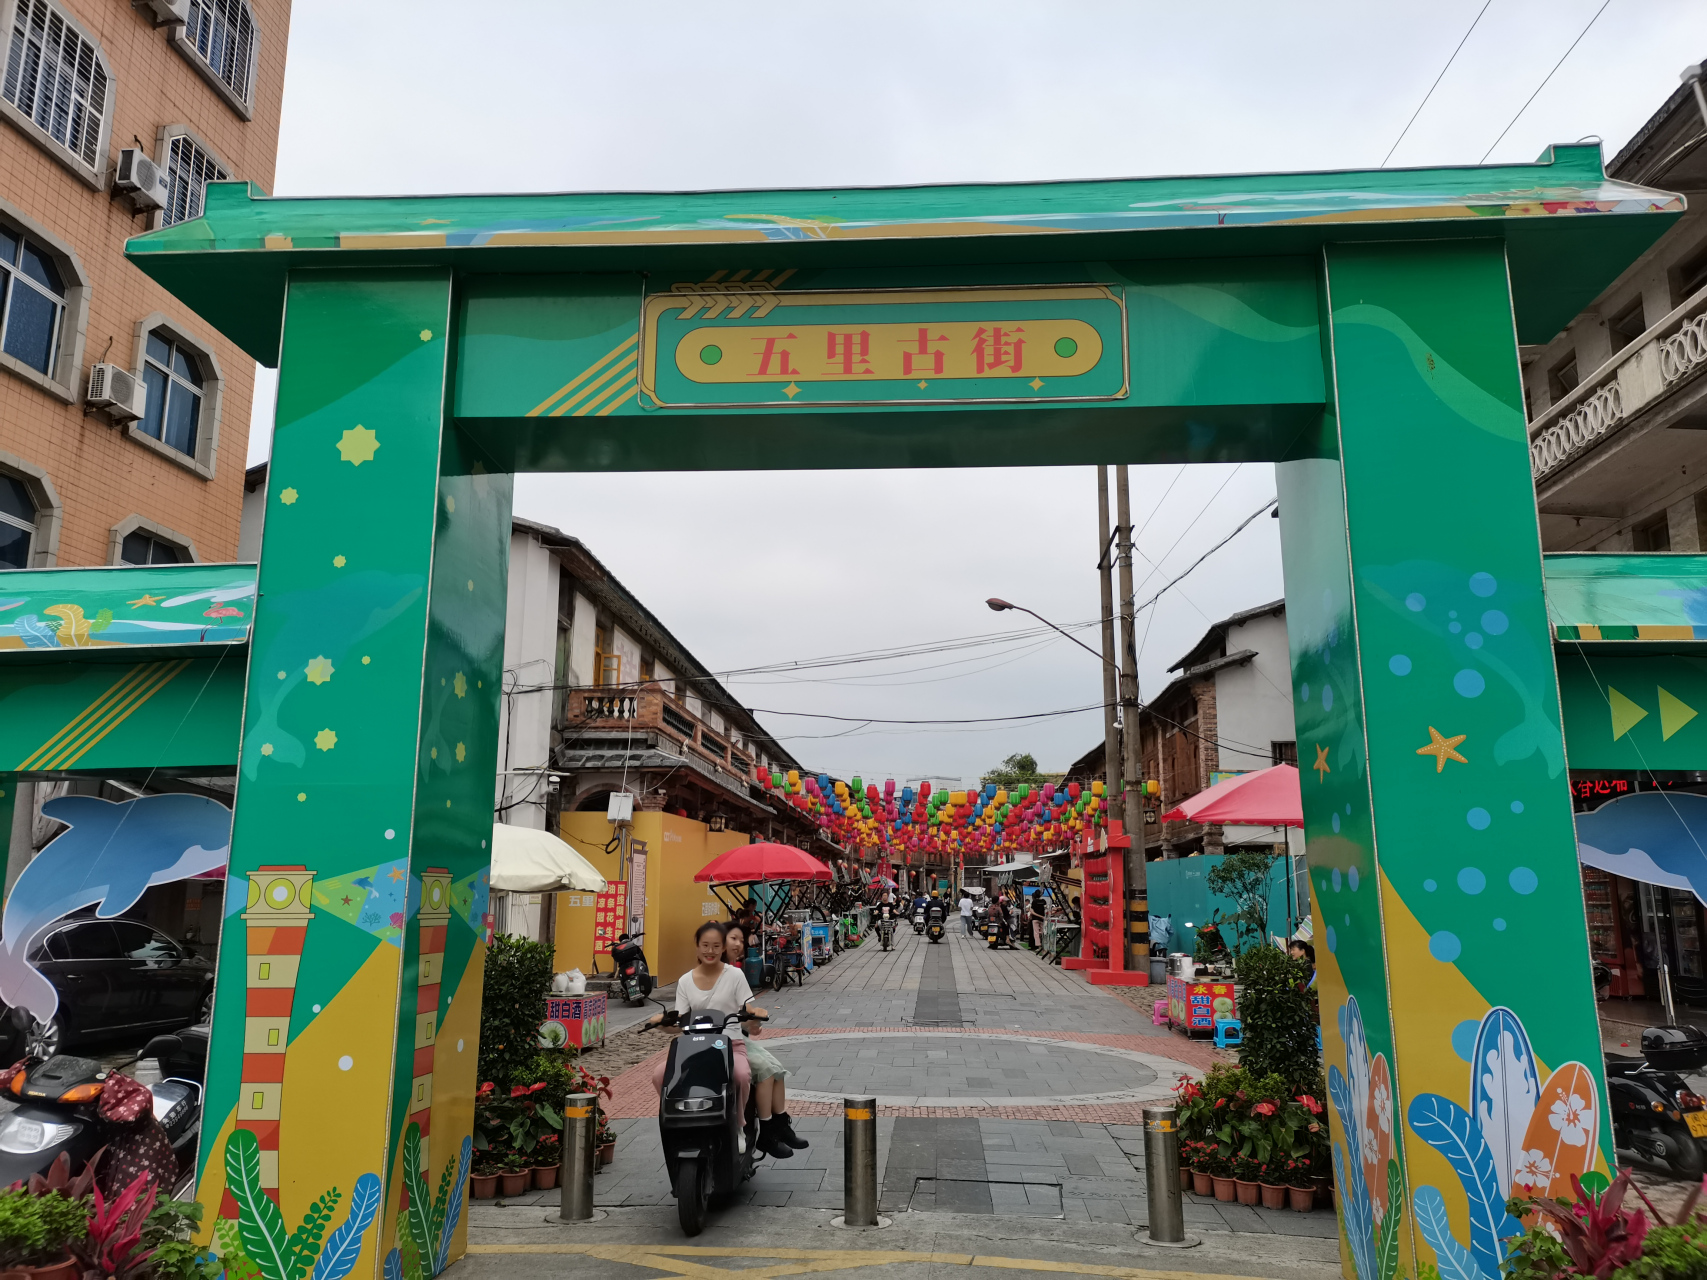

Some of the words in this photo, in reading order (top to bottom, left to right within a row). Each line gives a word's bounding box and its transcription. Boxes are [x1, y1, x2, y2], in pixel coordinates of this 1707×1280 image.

[746, 327, 1027, 377] 五里古街
[595, 890, 606, 951] 凉甜白酒
[1193, 985, 1227, 995] 永春
[550, 1001, 582, 1020] 甜白酒
[1190, 996, 1212, 1026] 甜白酒
